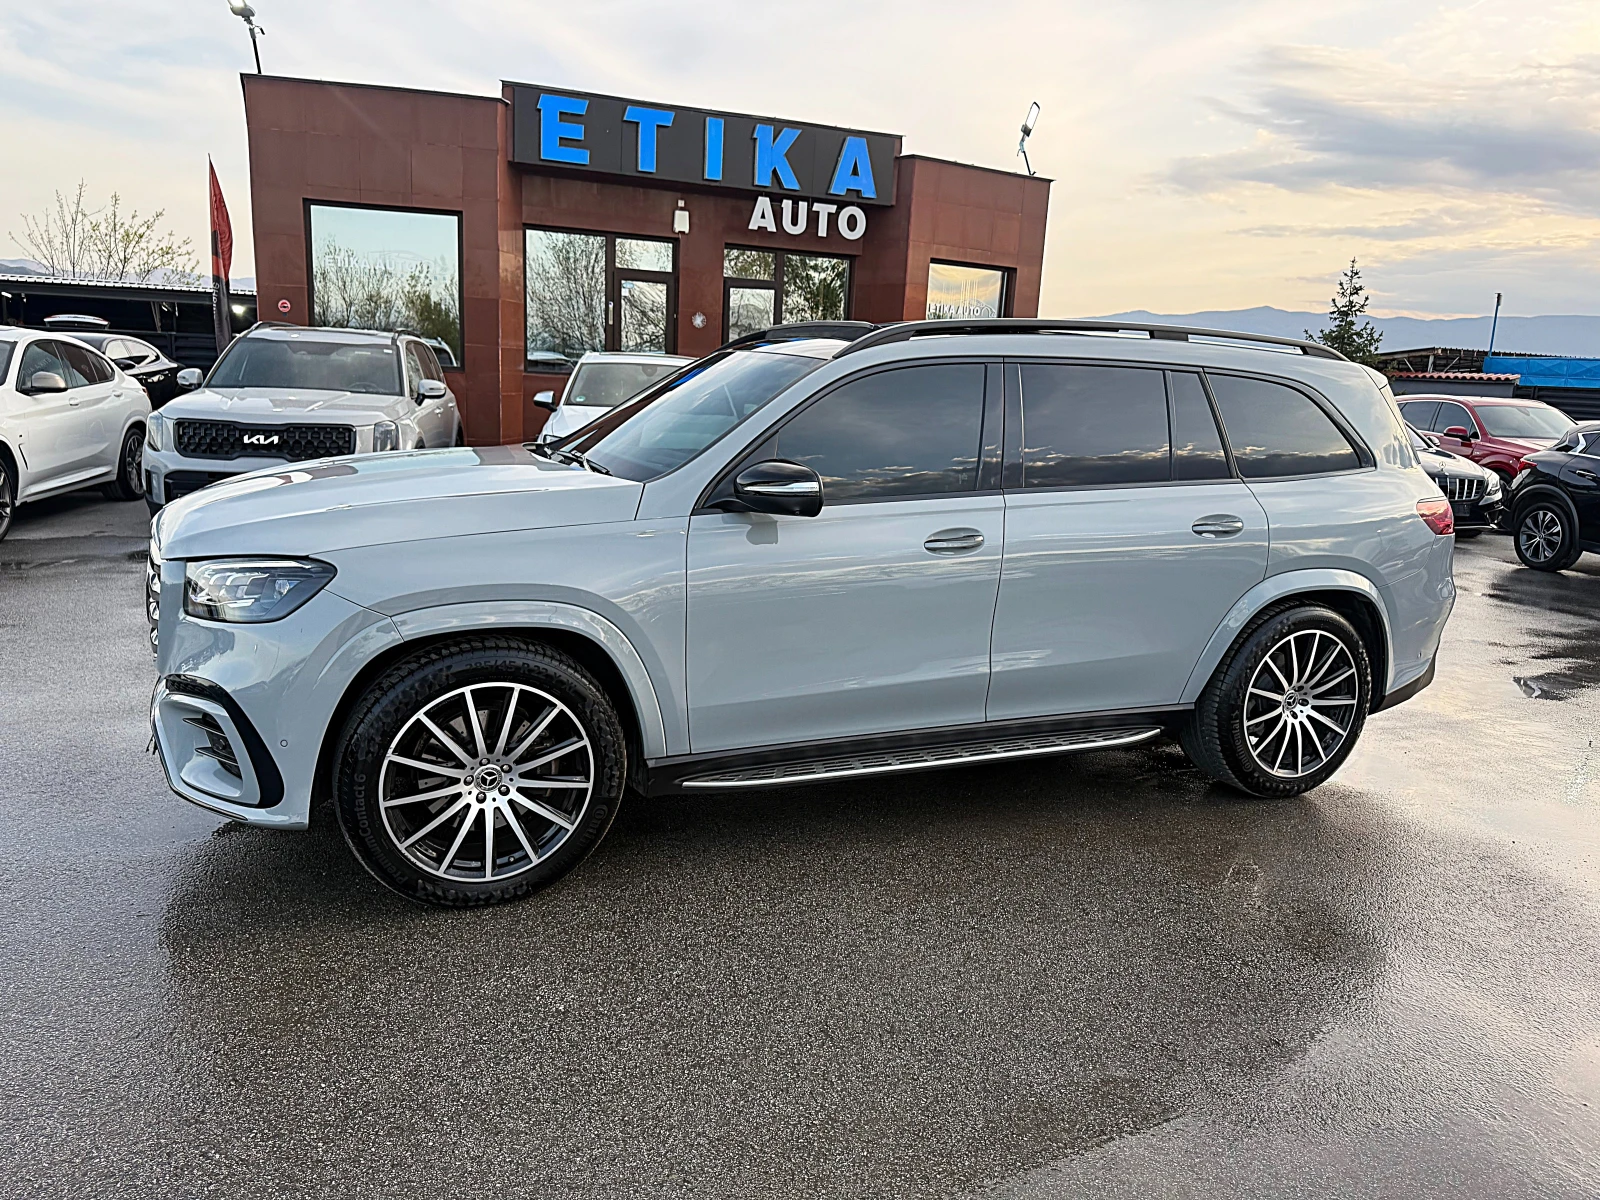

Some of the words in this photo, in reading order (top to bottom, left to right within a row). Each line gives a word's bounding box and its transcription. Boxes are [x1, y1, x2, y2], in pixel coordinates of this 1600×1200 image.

[537, 94, 877, 198] ETIKA
[748, 196, 867, 240] AUTO
[324, 255, 371, 270] ETIKA
[958, 305, 981, 316] AUTO
[243, 434, 279, 445] KIA
[1231, 719, 1253, 772] Continental
[354, 773, 367, 783] 6
